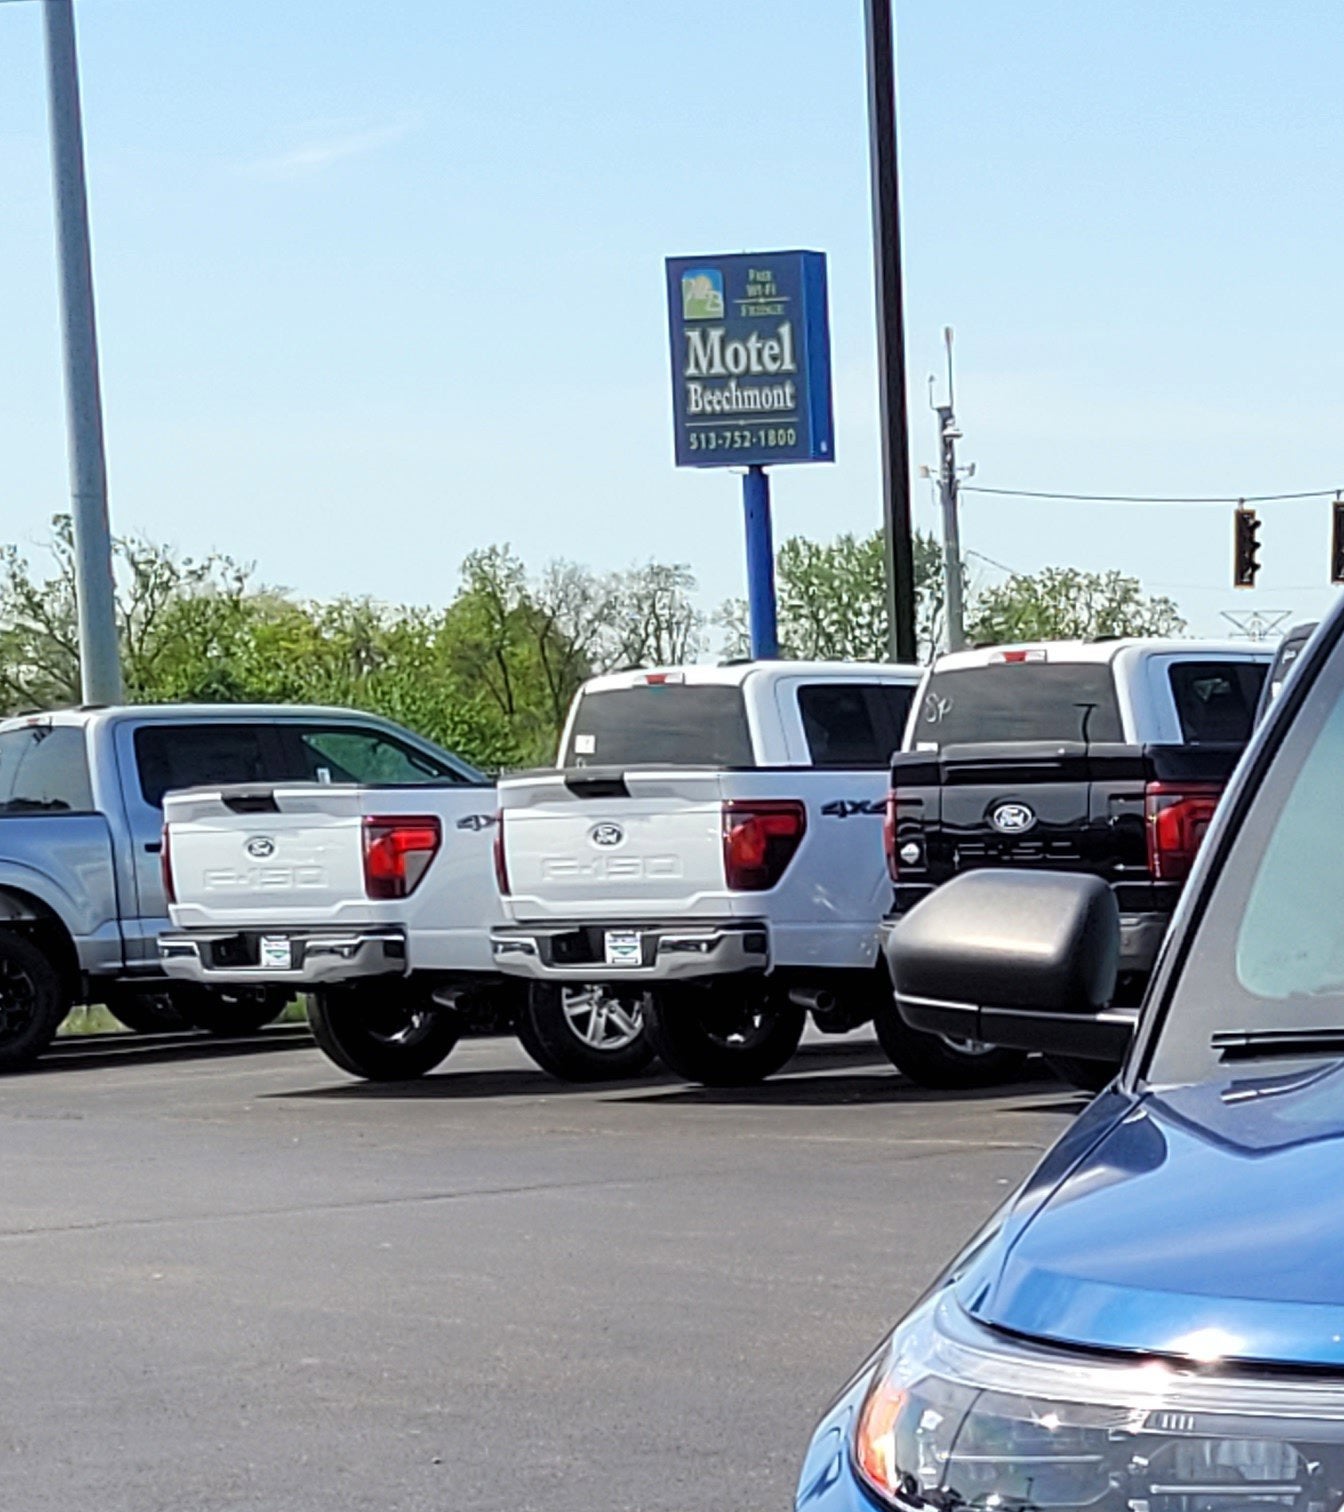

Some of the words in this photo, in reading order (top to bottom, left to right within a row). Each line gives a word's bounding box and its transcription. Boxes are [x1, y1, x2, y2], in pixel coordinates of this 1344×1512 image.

[684, 320, 797, 377] Motel
[687, 378, 796, 414] Beechmont
[203, 865, 329, 891] F-150
[541, 853, 684, 881] F-150
